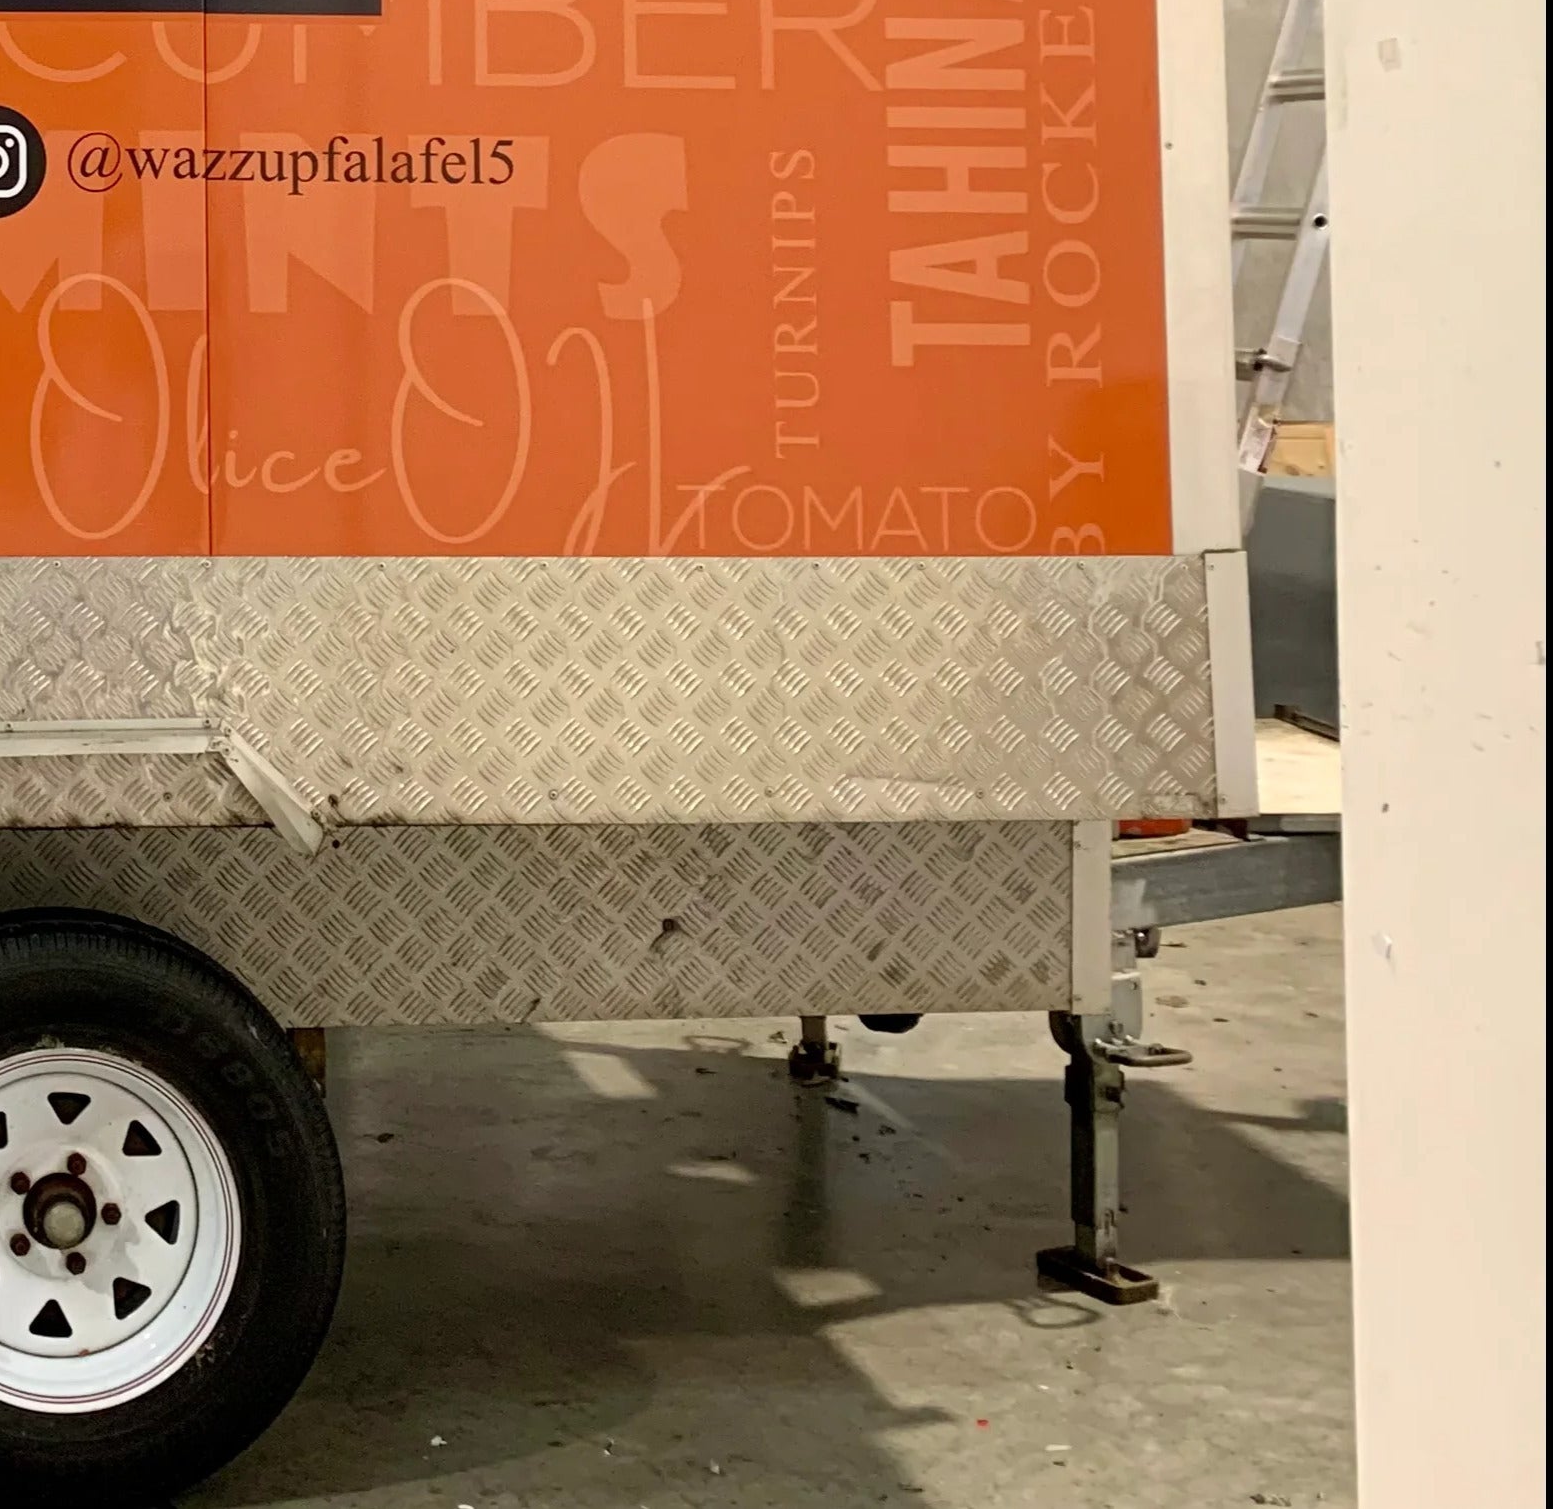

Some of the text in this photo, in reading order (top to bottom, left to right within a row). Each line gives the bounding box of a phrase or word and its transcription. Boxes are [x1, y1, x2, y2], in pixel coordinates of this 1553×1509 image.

[66, 134, 516, 196] @wazzupfalafel5
[769, 146, 820, 460] TURNIPS
[676, 484, 1037, 554] TOMATO
